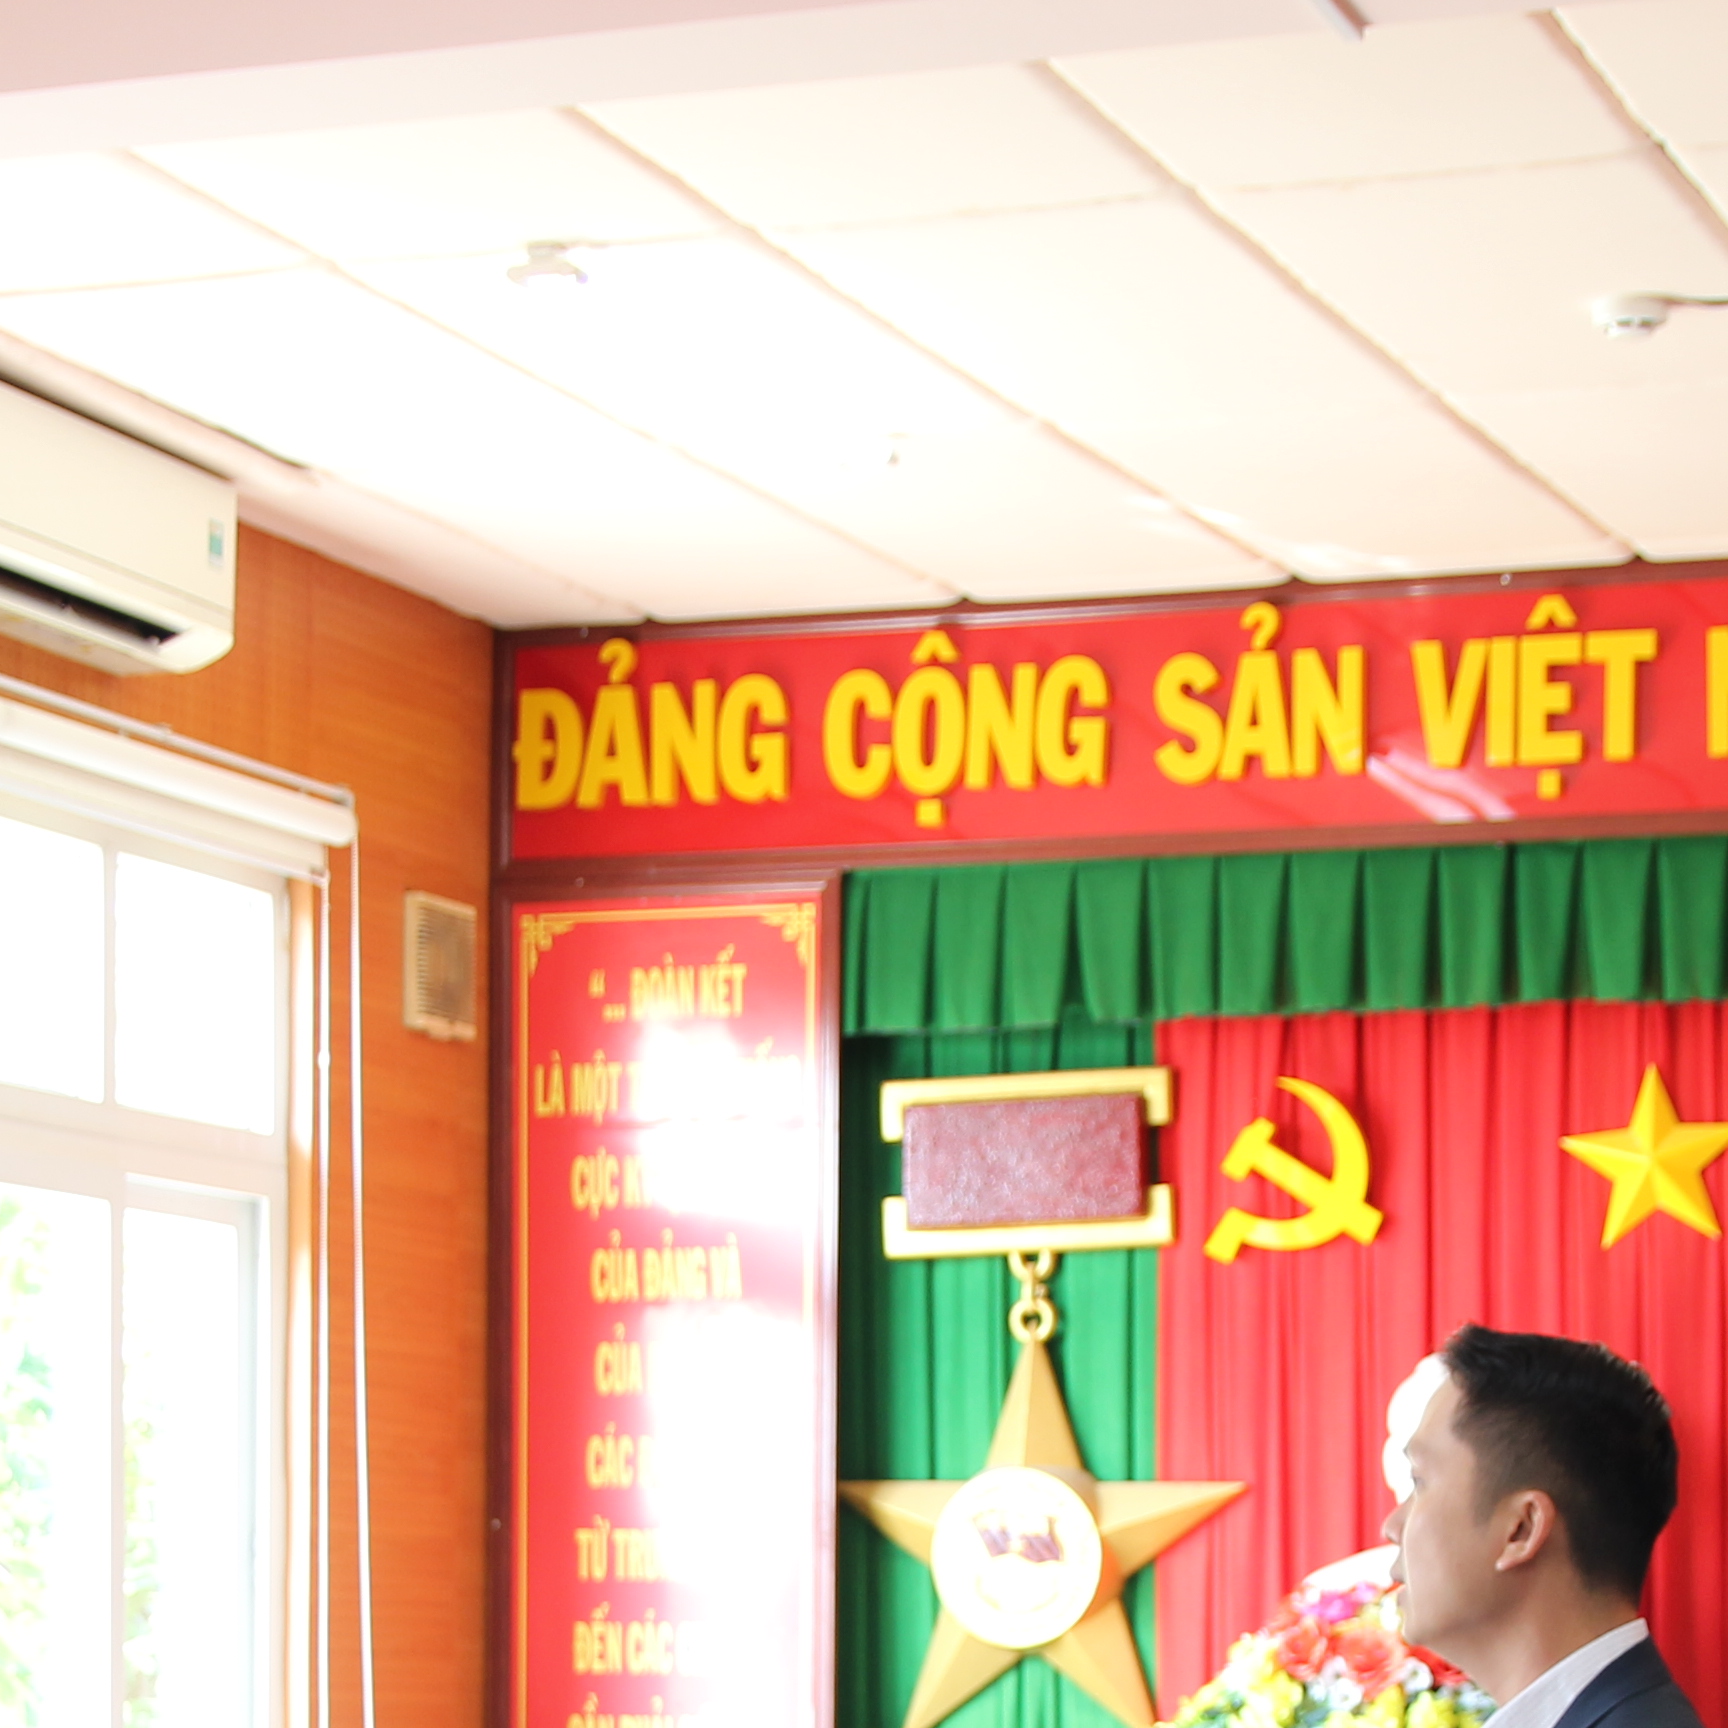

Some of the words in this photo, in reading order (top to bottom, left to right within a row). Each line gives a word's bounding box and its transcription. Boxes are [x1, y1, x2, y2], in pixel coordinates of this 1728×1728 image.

[513, 638, 791, 810] ĐẢNG
[822, 629, 1111, 827] CỘNG
[1152, 601, 1366, 786] SẢN
[1410, 594, 1659, 801] VIỆT
[630, 953, 696, 1022] ĐOÀN
[700, 944, 747, 1019] KẾT
[534, 1050, 566, 1118] LÀ
[570, 1049, 622, 1125] MỘT
[570, 1147, 619, 1220] CỰC
[590, 1229, 639, 1303] CỦA
[642, 1227, 707, 1302] ĐẢNG
[709, 1232, 743, 1301] VÀ
[595, 1323, 642, 1396] CỦA
[586, 1422, 635, 1491] CÁC
[575, 1515, 610, 1583] TỪ
[573, 1603, 623, 1676] ĐẾN
[626, 1608, 674, 1678] CÁC
